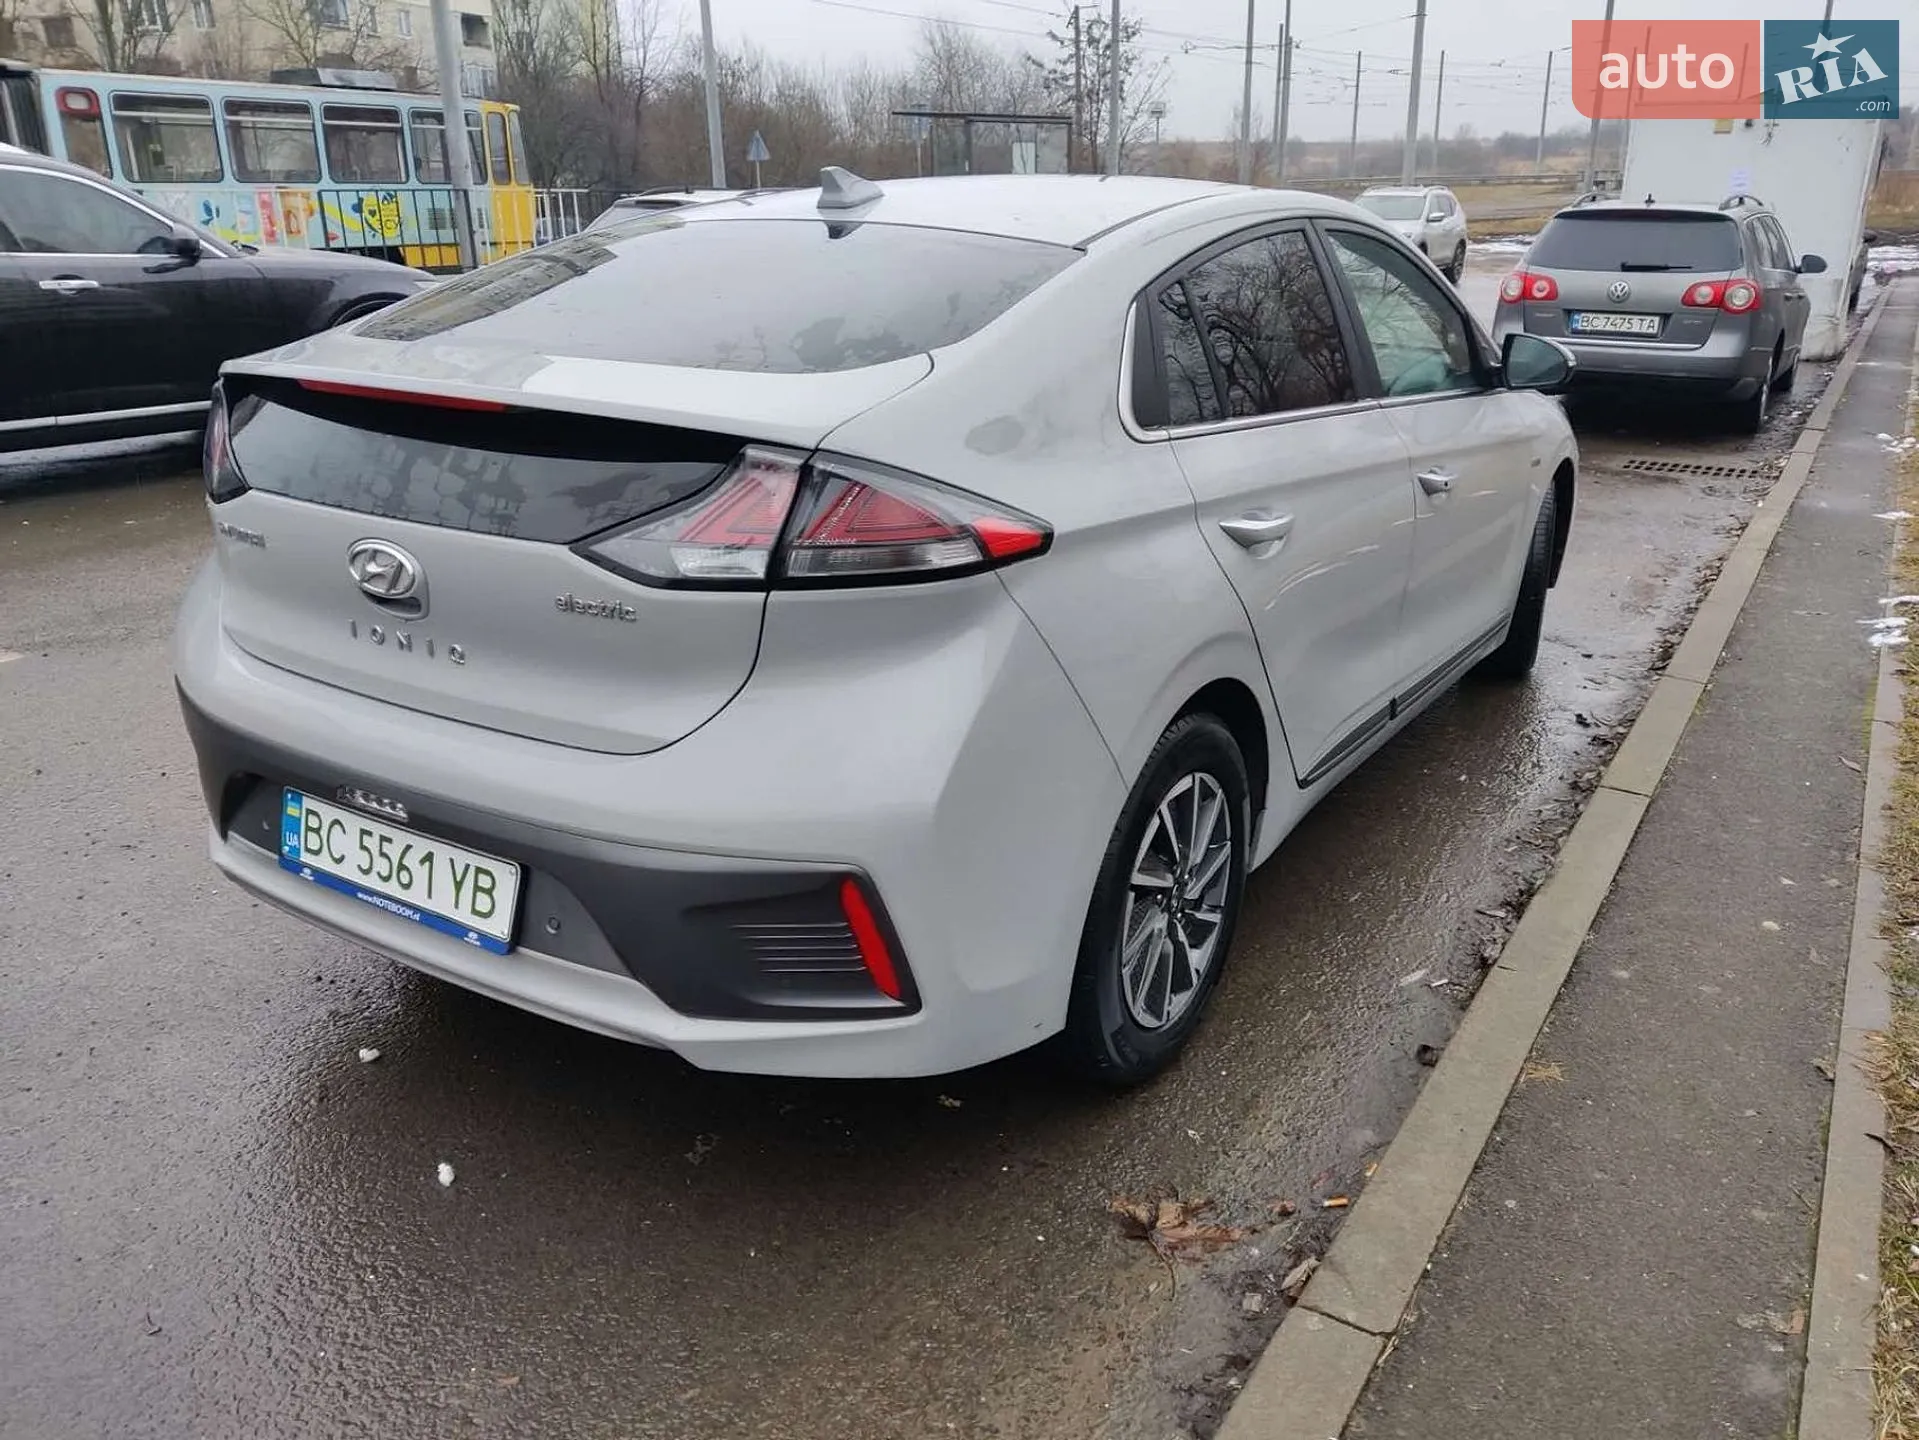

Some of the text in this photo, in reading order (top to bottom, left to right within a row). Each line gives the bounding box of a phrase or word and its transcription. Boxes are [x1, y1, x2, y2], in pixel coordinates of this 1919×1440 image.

[1580, 315, 1599, 328] BC
[1603, 316, 1634, 330] 7475
[1639, 319, 1655, 331] TA
[556, 592, 638, 622] electric
[348, 619, 466, 665] IONIQ
[286, 831, 300, 848] UA
[303, 808, 497, 919] BC 5561 YB
